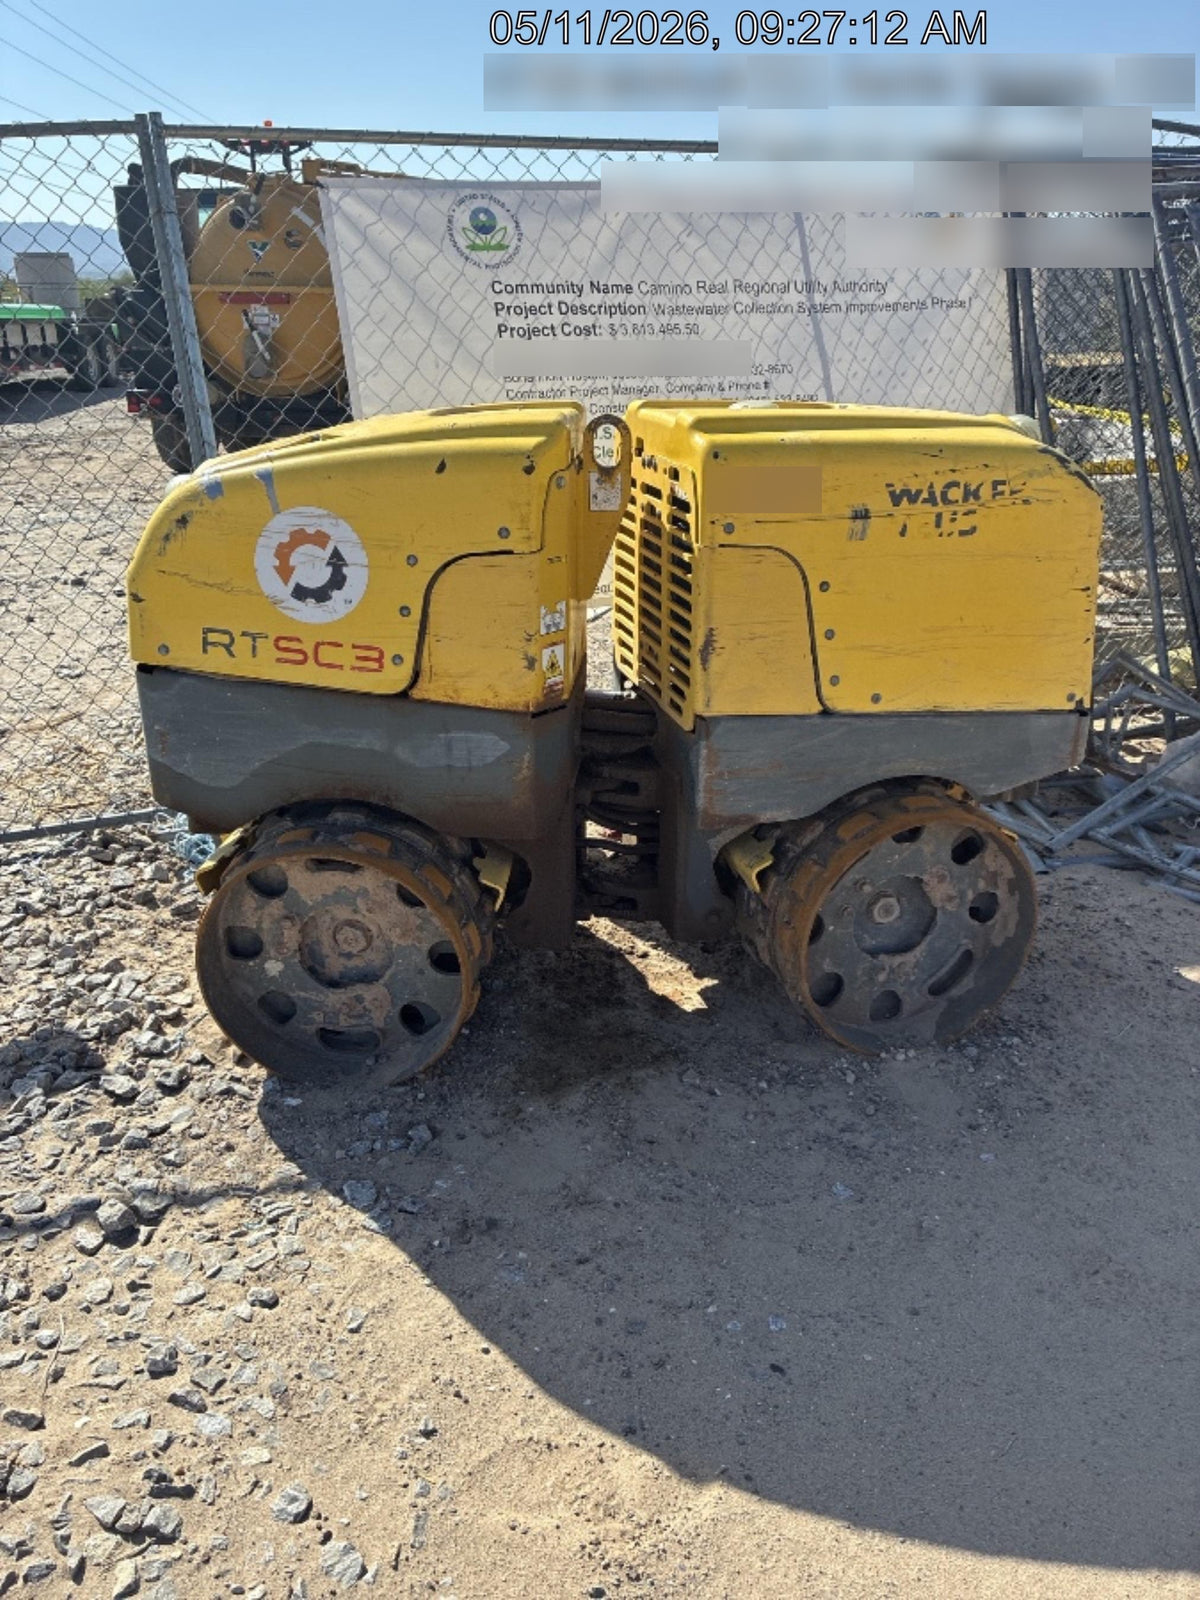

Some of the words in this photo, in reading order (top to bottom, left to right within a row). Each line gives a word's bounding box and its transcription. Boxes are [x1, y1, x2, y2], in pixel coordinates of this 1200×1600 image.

[491, 280, 584, 297] Community
[590, 280, 633, 294] Name
[637, 280, 692, 295] Camino
[696, 280, 728, 294] Real
[733, 279, 791, 297] Regional
[794, 279, 828, 297] Utility
[833, 279, 888, 295] Authority
[494, 302, 554, 319] Project
[558, 300, 646, 318] Description
[652, 302, 730, 316] Wastewater
[733, 301, 794, 315] Collection
[797, 301, 842, 317] System
[845, 298, 928, 315] Improvements
[497, 323, 557, 340] Project
[561, 322, 602, 337] Cost:
[666, 381, 716, 395] Company
